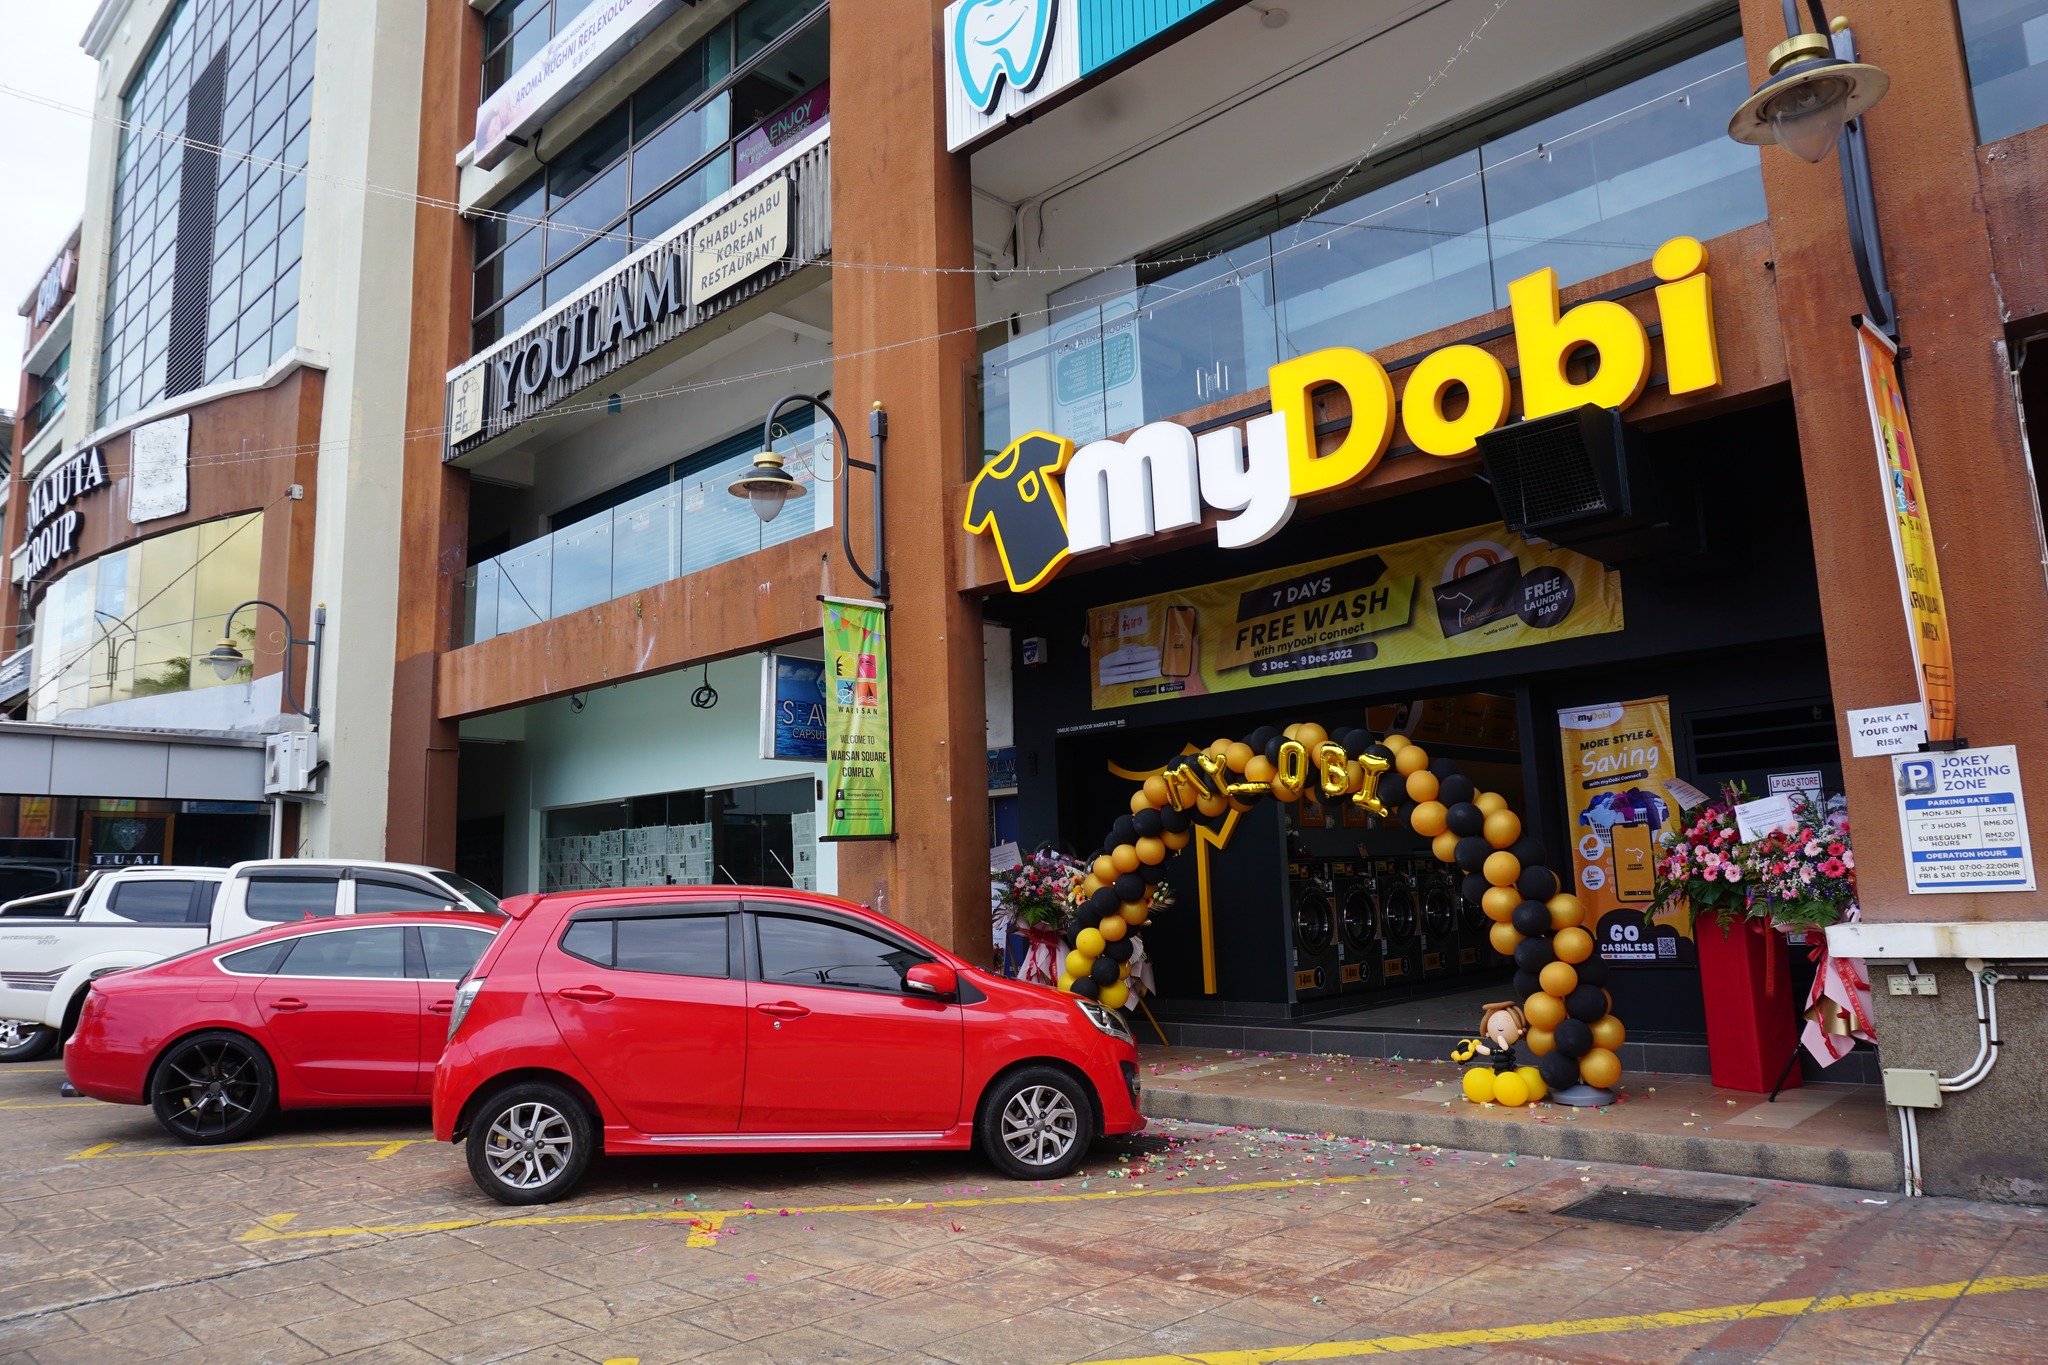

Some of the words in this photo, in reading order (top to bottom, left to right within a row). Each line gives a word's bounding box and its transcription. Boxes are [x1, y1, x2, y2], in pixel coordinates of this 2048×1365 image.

[515, 73, 543, 105] AROMA
[544, 43, 577, 81] MUGHNI
[769, 98, 813, 141] ENJOY
[775, 118, 811, 147] massage
[699, 190, 781, 254] SHABU-SHABU
[716, 223, 763, 264] KOREAN
[701, 235, 777, 291] RESTAURANT
[496, 252, 686, 412] YOULAM
[1103, 320, 1132, 337] HOURS
[1065, 236, 1723, 549] myDobi
[27, 446, 104, 535] MAJUTA
[25, 510, 77, 583] GROUP
[1272, 590, 1282, 607] 7
[1287, 577, 1332, 604] DAYS
[1524, 576, 1561, 601] FREE
[1524, 588, 1569, 612] LAUNDRY
[1538, 603, 1559, 617] BAG
[1122, 616, 1143, 633] Hiro
[1236, 614, 1296, 651] FREE
[1303, 586, 1390, 632] WASH
[1253, 644, 1275, 659] with
[1277, 633, 1317, 653] myDobi
[1319, 621, 1365, 642] Connect
[1262, 662, 1268, 671] 3
[1270, 659, 1290, 671] Dec
[1301, 656, 1307, 666] 9
[1308, 653, 1328, 664] Dec
[1328, 649, 1354, 662] 2022
[838, 706, 878, 715] WARISAN
[1862, 715, 1893, 725] PARK
[1895, 713, 1910, 722] AT
[1858, 727, 1889, 738] YOUR
[1892, 724, 1918, 733] OWN
[867, 736, 875, 745] TO
[1580, 738, 1610, 751] MORE
[1612, 730, 1644, 745] STYLE
[1645, 730, 1654, 738] &
[1876, 737, 1903, 748] RISK
[861, 750, 887, 762] SQUARE
[1582, 746, 1659, 777] Saving
[1941, 755, 1990, 768] JOKEY
[842, 766, 875, 778] COMPLEX
[1600, 776, 1620, 785] myDobi
[1620, 772, 1642, 780] Connect
[1907, 764, 1928, 790] P
[1942, 765, 2011, 780] PARKING
[1772, 779, 1780, 789] LP
[1782, 778, 1796, 788] GAS
[1796, 776, 1819, 787] STORE
[1944, 778, 1987, 791] ZONE
[1928, 798, 1966, 806] PARKING
[1967, 796, 1990, 804] RATE
[1984, 819, 2014, 827] RM6.00
[1918, 834, 1972, 842] SUBSEQUENT
[1926, 851, 1975, 860] OPERATION
[1959, 862, 2020, 871] 07:00-22:00HR
[1960, 870, 2021, 878] 07:00-23:00HR
[1610, 924, 1640, 942] GO
[1601, 942, 1655, 952] CASHLESS
[1298, 973, 1312, 986] 14KG
[1316, 971, 1322, 984] 1
[1345, 966, 1357, 979] 14KG
[1362, 966, 1368, 978] 2
